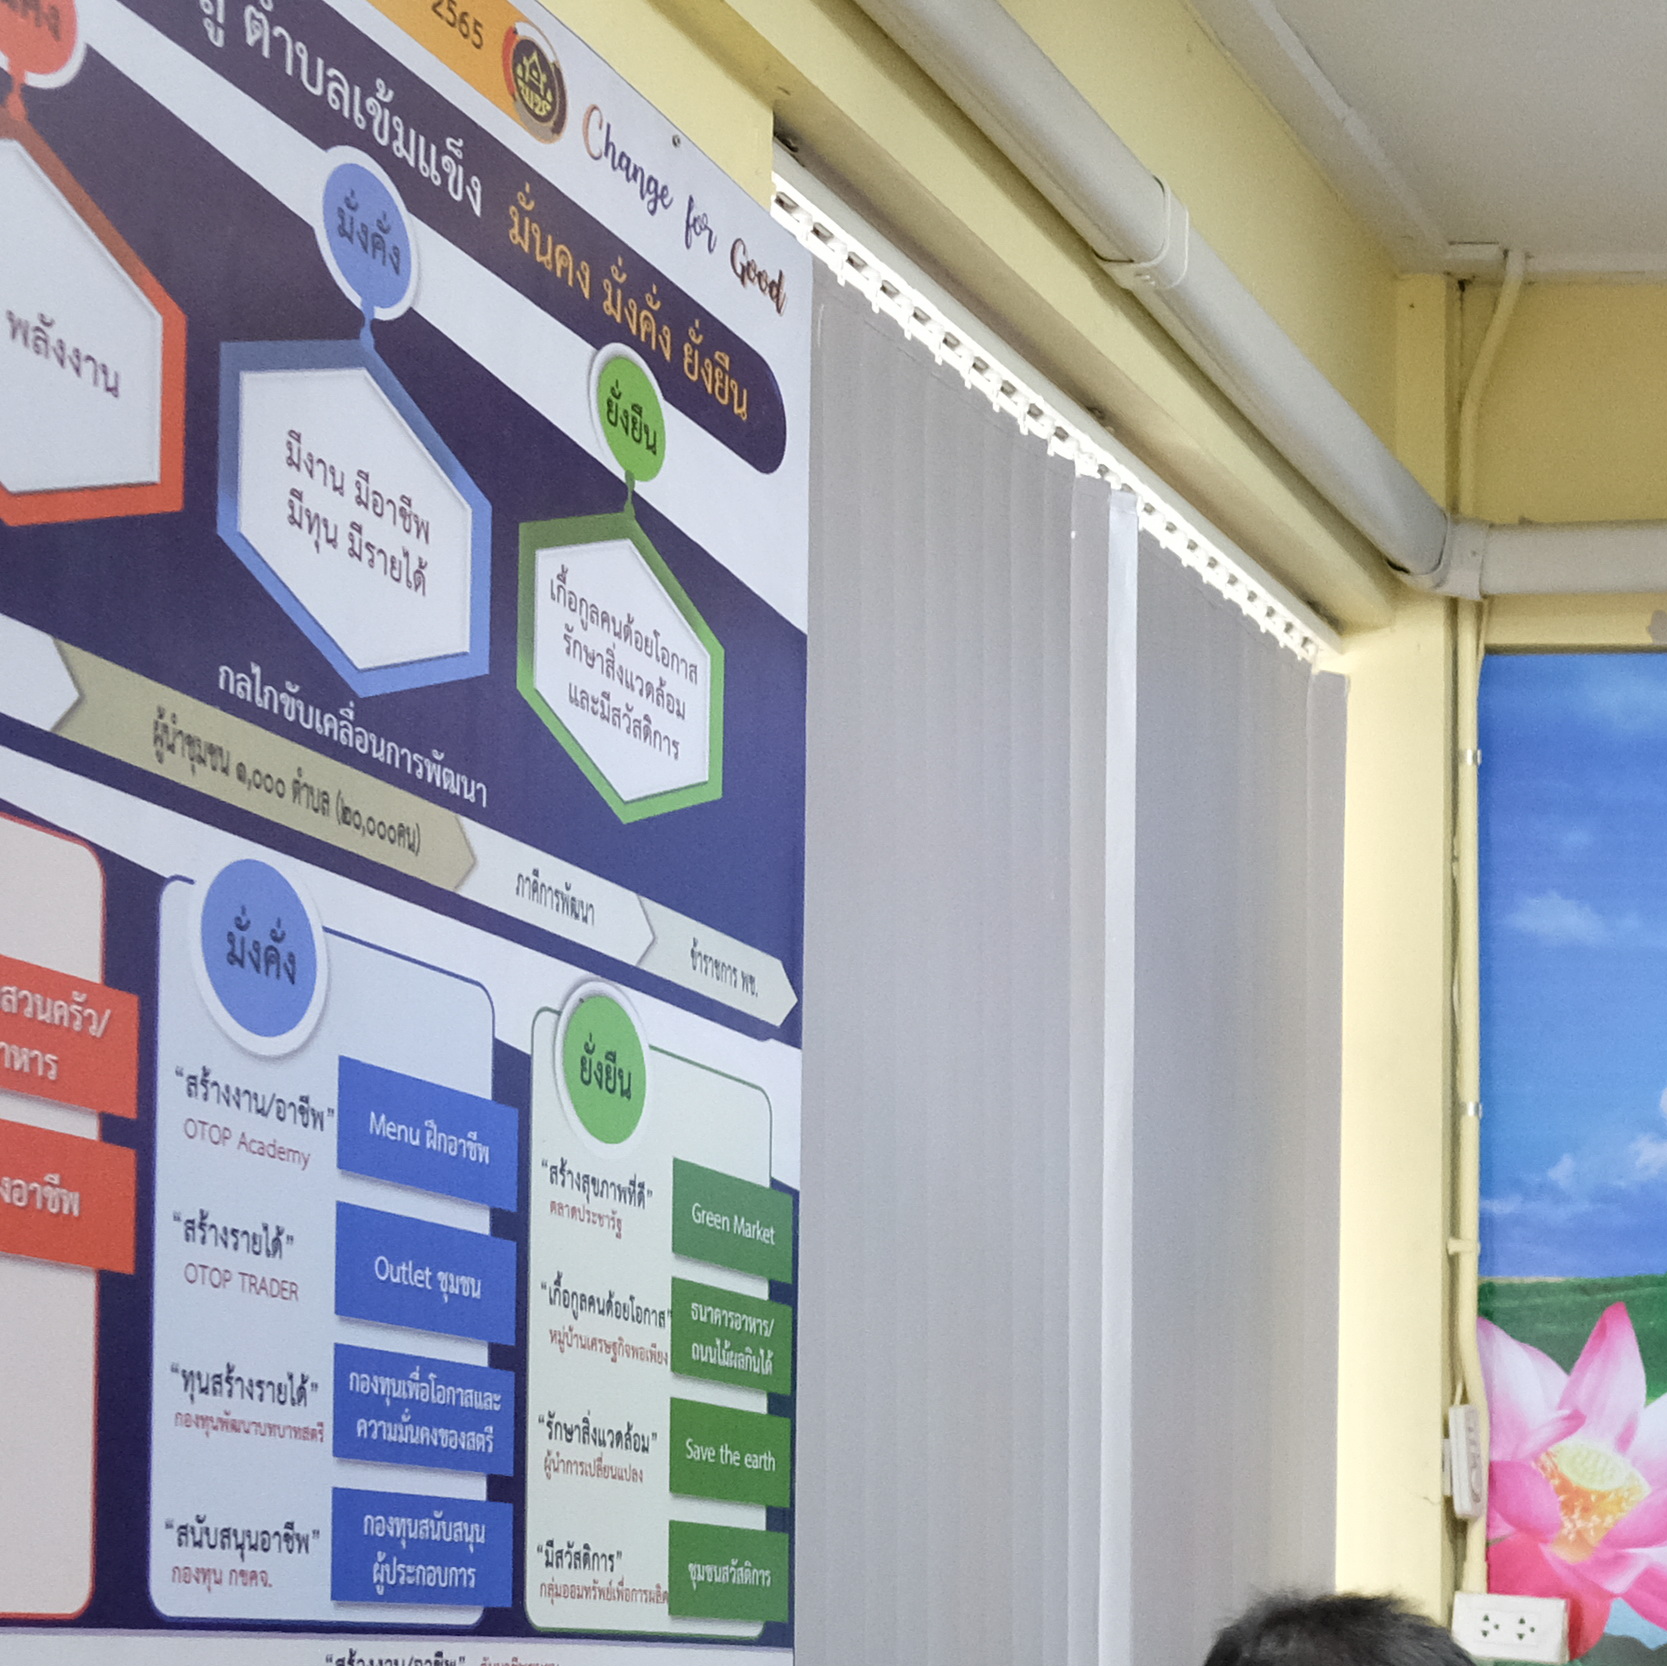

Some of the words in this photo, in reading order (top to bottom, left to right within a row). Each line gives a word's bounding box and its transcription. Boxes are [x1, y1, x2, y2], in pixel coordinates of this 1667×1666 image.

[431, 0, 485, 50] 2565
[244, 0, 482, 216] ตำบลเข้มแข็ง
[508, 181, 591, 299] มั่นคง
[602, 256, 672, 362] มั่งคั่ง
[683, 318, 749, 421] ยั่งยืน
[336, 189, 401, 275] มั่งคั่ง
[582, 104, 673, 216] Change
[684, 195, 717, 254] for
[730, 238, 788, 316] Good
[6, 310, 120, 399] พลังงาน
[605, 379, 658, 456] ยั่งยืน
[286, 430, 345, 497] มีงาน
[355, 469, 430, 545] มีอาชีพ
[287, 488, 338, 554] มีทุน
[347, 528, 427, 597] มีรายได้
[550, 565, 698, 686] เกื้อกูลคนด้อยโอกาส
[563, 624, 686, 721] รักษาสิ่งแวดล้อม
[217, 658, 488, 808] กลไกขับเคลื่อนการพัฒนา
[568, 682, 680, 761] และมีสวัสดิการ
[153, 704, 231, 784] ผู้นำชุมชน
[290, 769, 331, 817] ตำบล
[514, 868, 596, 927] ภาคีการพัฒนา
[226, 905, 297, 985] มั่งคั่ง
[689, 937, 737, 990] ข้าราชการ
[579, 1033, 632, 1102] ยั่งยืน
[183, 1118, 232, 1147] OTOP
[237, 1126, 311, 1172] Academy
[369, 1111, 421, 1146] Menu
[424, 1118, 491, 1167] ฝึกอาชีพ
[691, 1202, 730, 1235] Green
[732, 1213, 775, 1247] Market
[184, 1262, 232, 1290] OTOP
[238, 1271, 300, 1302] TRADER
[374, 1255, 432, 1292] Outlet
[436, 1268, 482, 1303] ชุมชน
[348, 1365, 502, 1412] กองทุนเพื่อโอกาสและ
[356, 1408, 494, 1454] ความมั่นคงของสตรี
[685, 1439, 717, 1467] Save
[719, 1443, 741, 1467] the
[744, 1446, 776, 1473] earth
[363, 1509, 486, 1554] กองทุนสนับสนุน
[372, 1552, 476, 1599] ผู้ประกอบการ
[688, 1560, 772, 1590] ชุมชนสวัสดิการ
